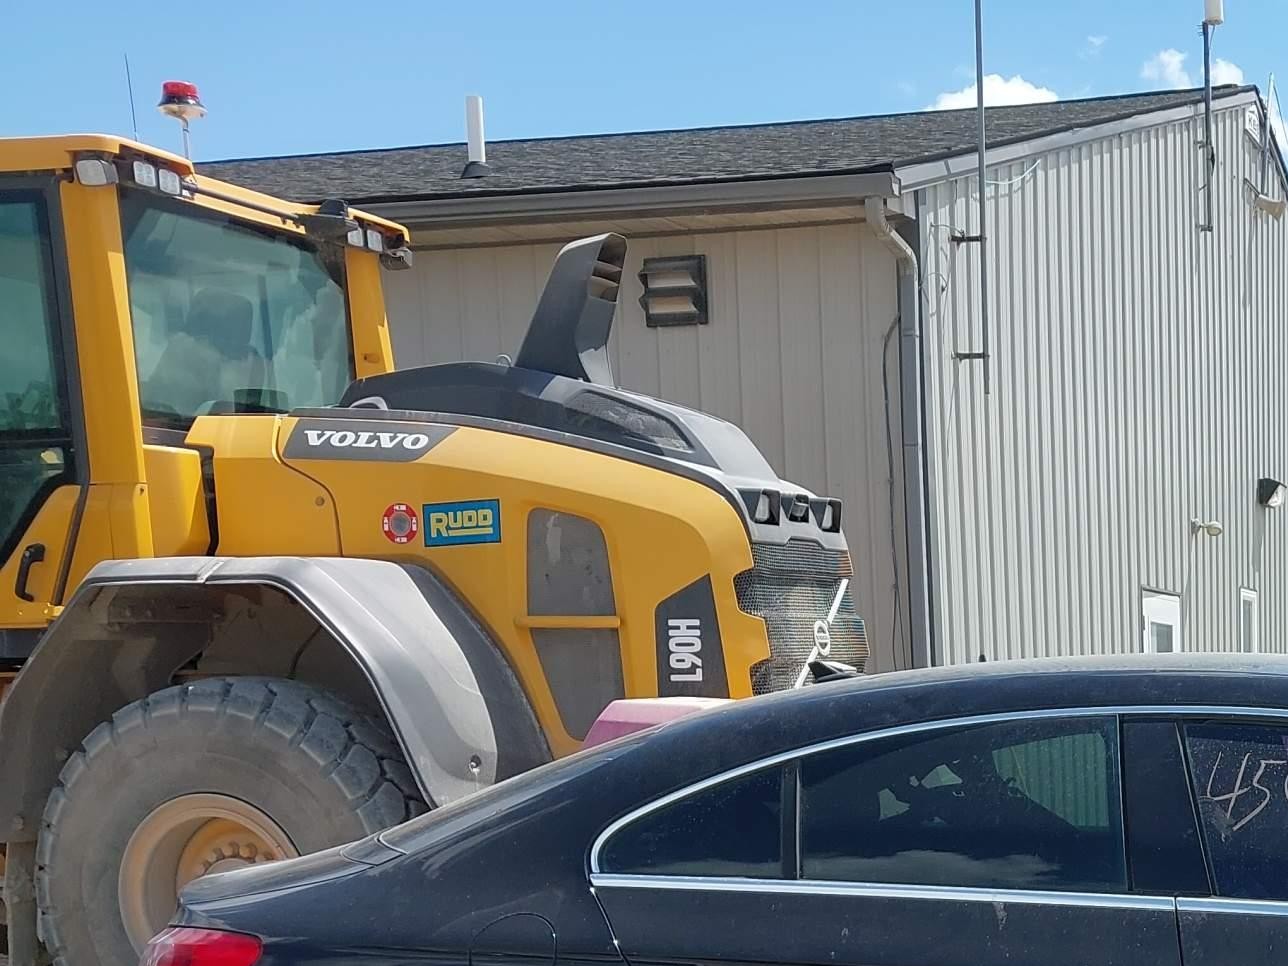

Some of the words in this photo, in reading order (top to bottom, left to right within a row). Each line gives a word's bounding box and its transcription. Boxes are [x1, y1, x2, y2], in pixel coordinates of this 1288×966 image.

[304, 430, 429, 450] VOLVO
[430, 508, 493, 538] RUDD
[667, 618, 703, 682] L90H
